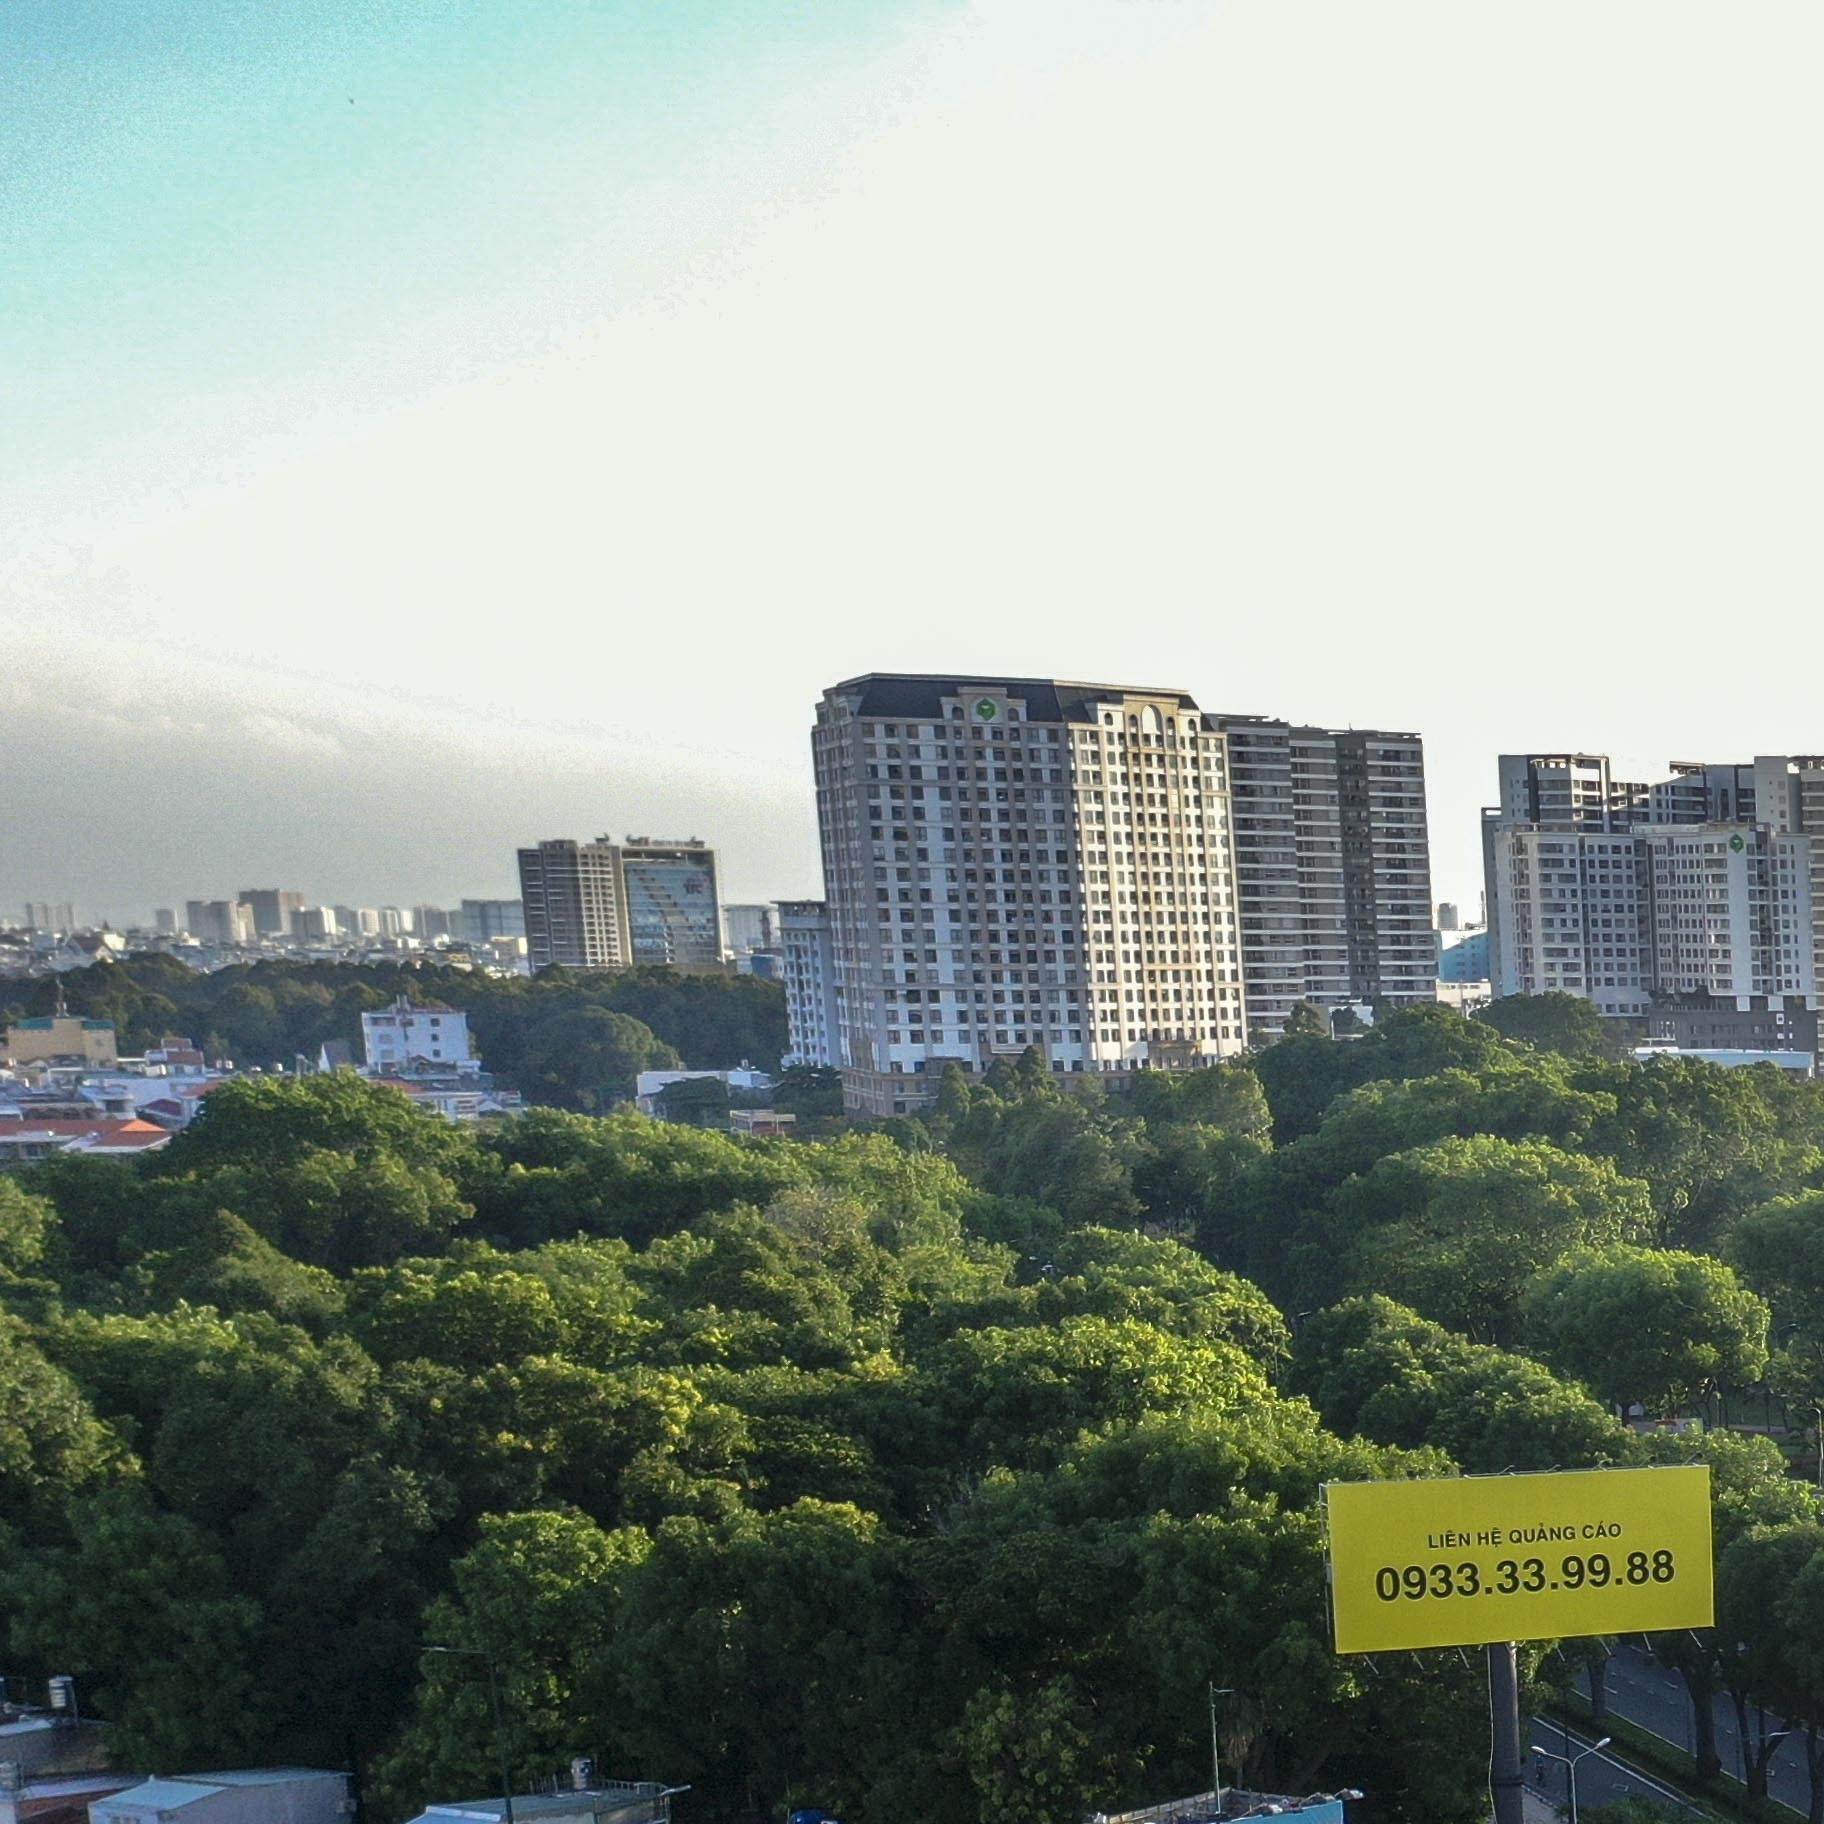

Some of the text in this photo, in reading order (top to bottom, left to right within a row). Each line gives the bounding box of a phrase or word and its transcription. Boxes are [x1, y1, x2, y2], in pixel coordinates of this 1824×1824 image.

[1427, 1520, 1622, 1549] LIÊN HỆ QUẢNG CÁO
[1375, 1549, 1675, 1602] 0933.33.99.88
